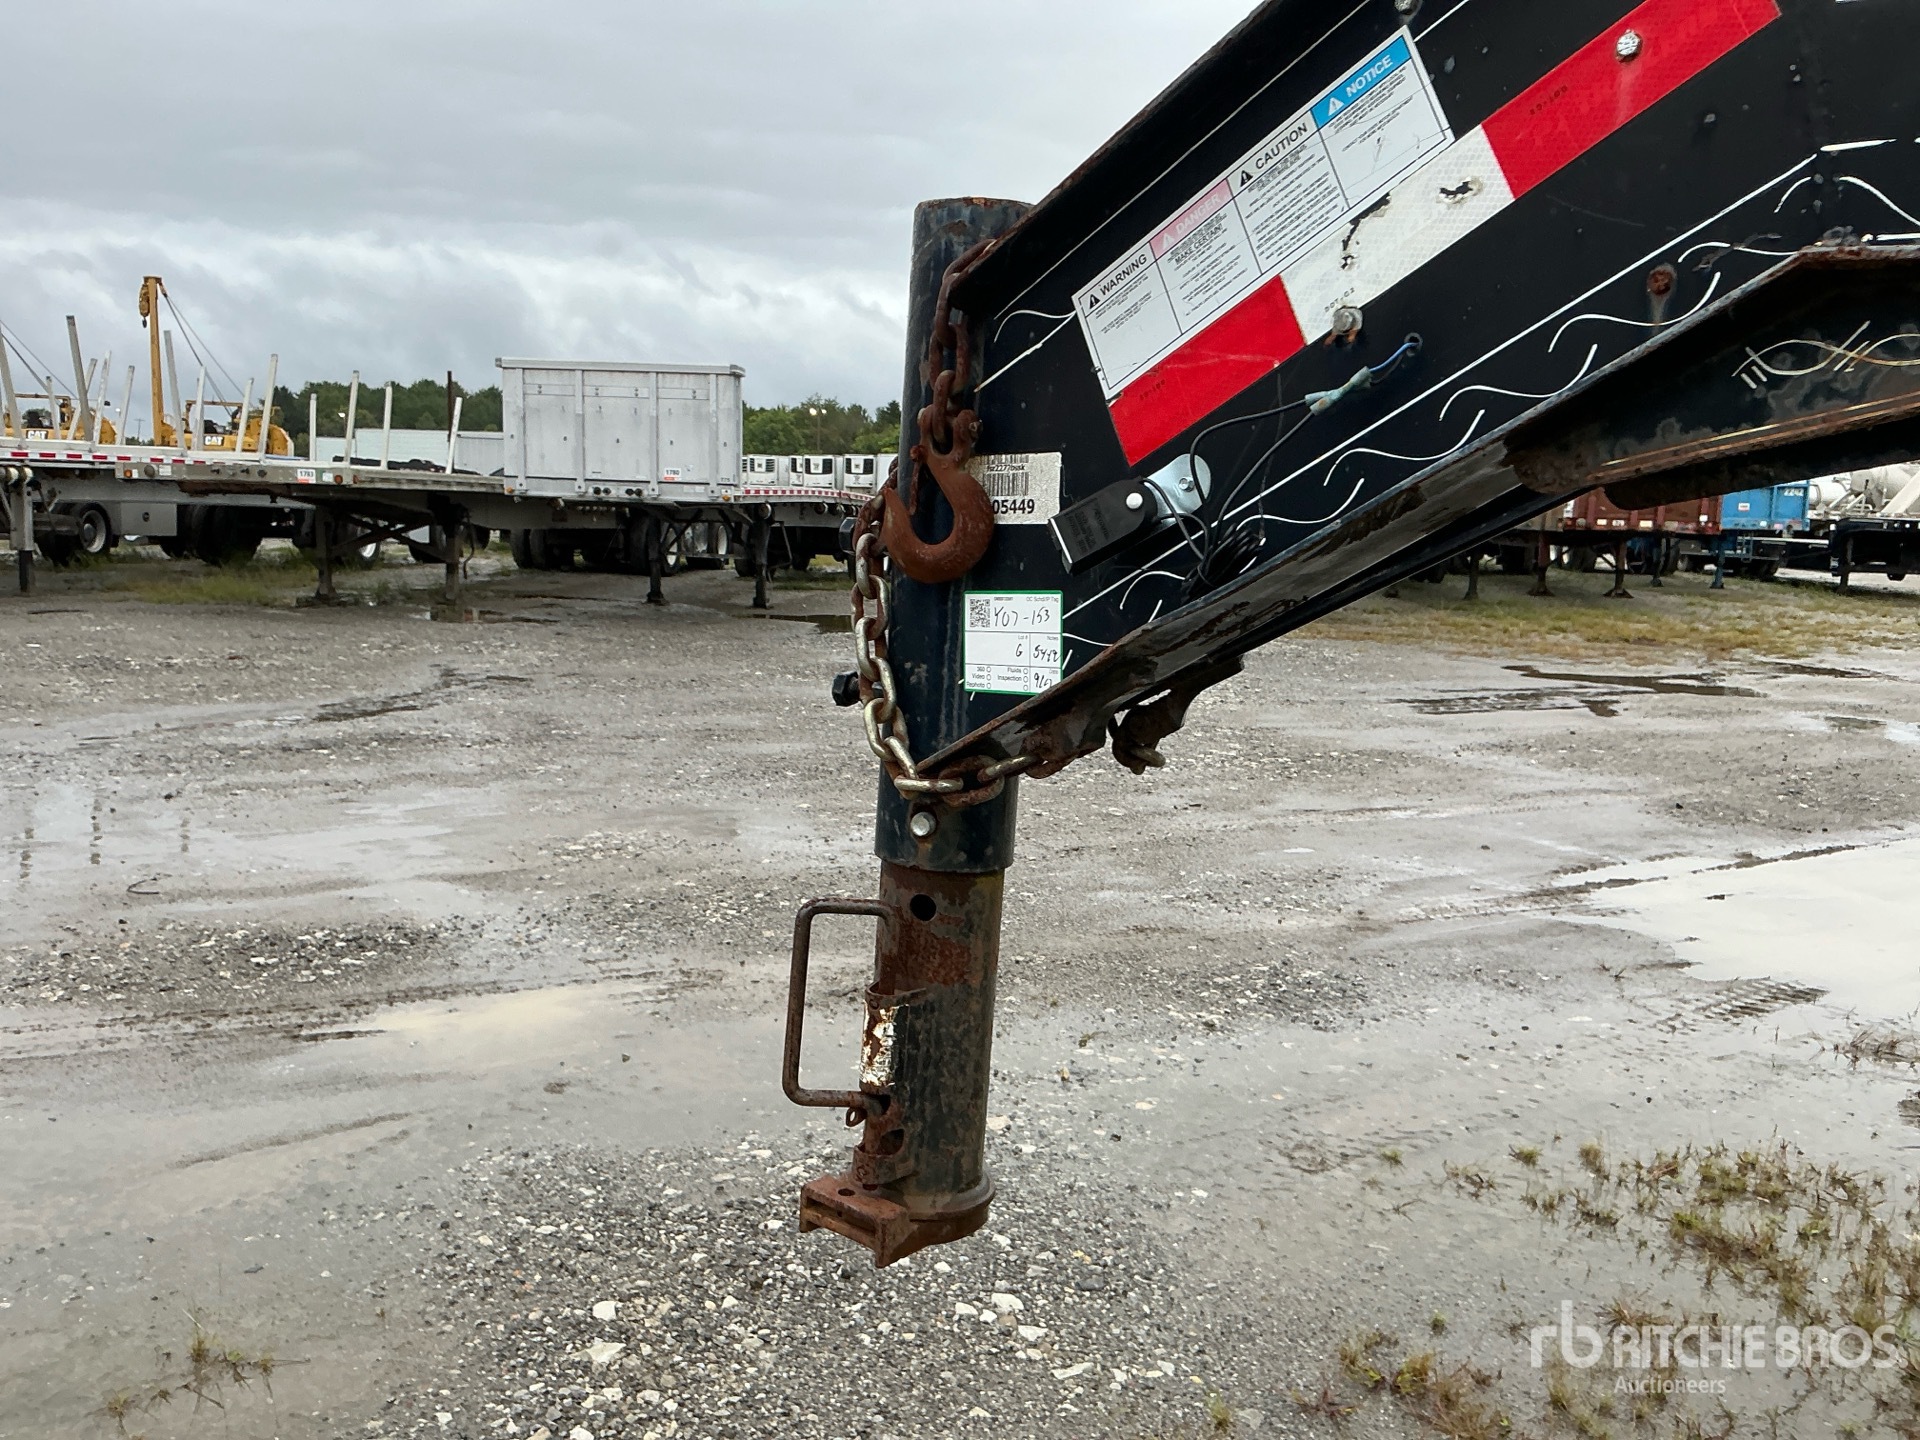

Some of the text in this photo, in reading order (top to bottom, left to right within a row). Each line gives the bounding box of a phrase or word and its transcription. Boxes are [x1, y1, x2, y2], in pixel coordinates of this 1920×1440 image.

[1345, 54, 1394, 98] NOTICE
[1254, 121, 1308, 170] CAUTION
[1175, 192, 1221, 234] DANGER
[1099, 252, 1148, 296] WARNING
[1325, 287, 1356, 313] DOT-C2
[28, 430, 47, 439] CAT
[204, 436, 223, 445] CAT
[992, 499, 1035, 514] 05449
